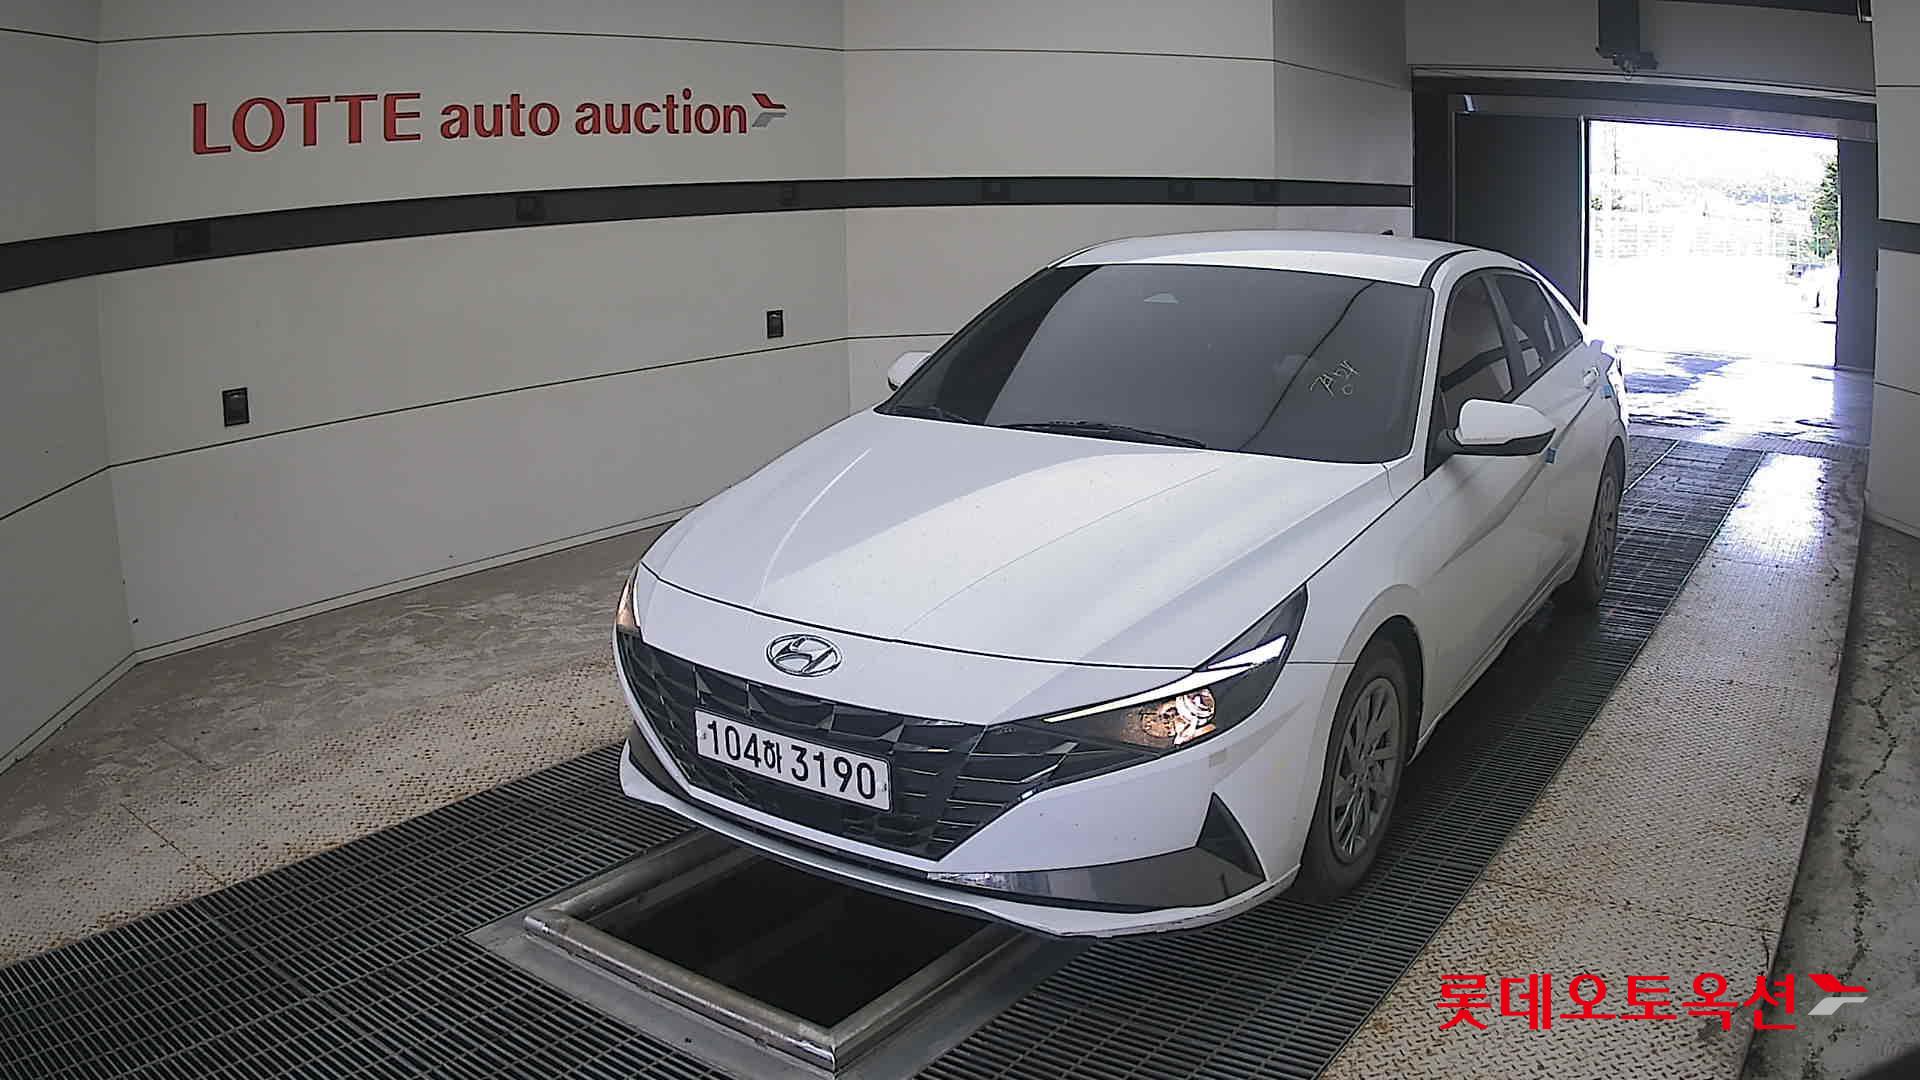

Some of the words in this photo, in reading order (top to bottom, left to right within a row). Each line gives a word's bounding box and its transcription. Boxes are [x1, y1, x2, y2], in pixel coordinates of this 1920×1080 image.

[192, 92, 421, 155] LOTTE
[440, 94, 560, 139] auto
[575, 88, 748, 135] auction
[791, 745, 876, 800] 3190
